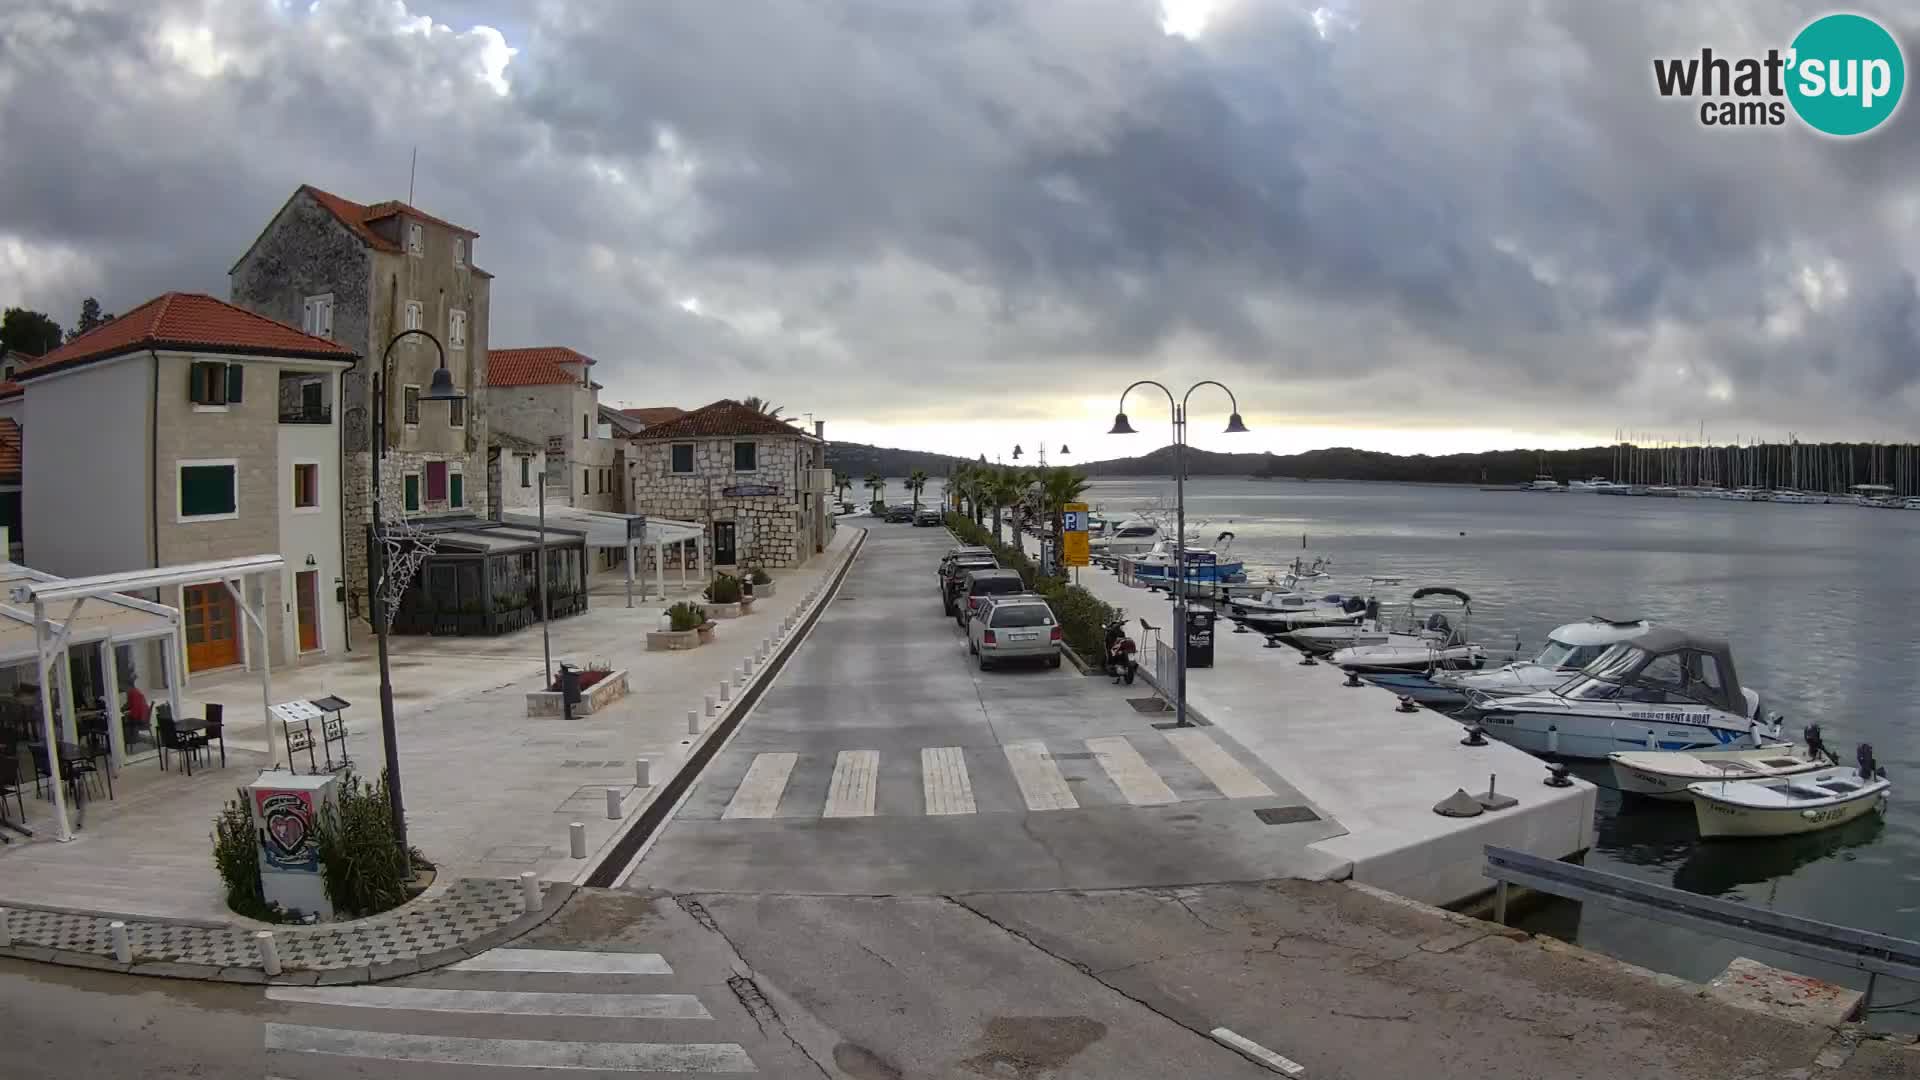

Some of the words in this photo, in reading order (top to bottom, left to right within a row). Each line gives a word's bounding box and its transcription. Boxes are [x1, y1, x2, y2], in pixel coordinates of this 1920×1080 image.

[1065, 513, 1076, 529] P
[1665, 713, 1684, 722] RENT
[1692, 714, 1710, 725] BOAT
